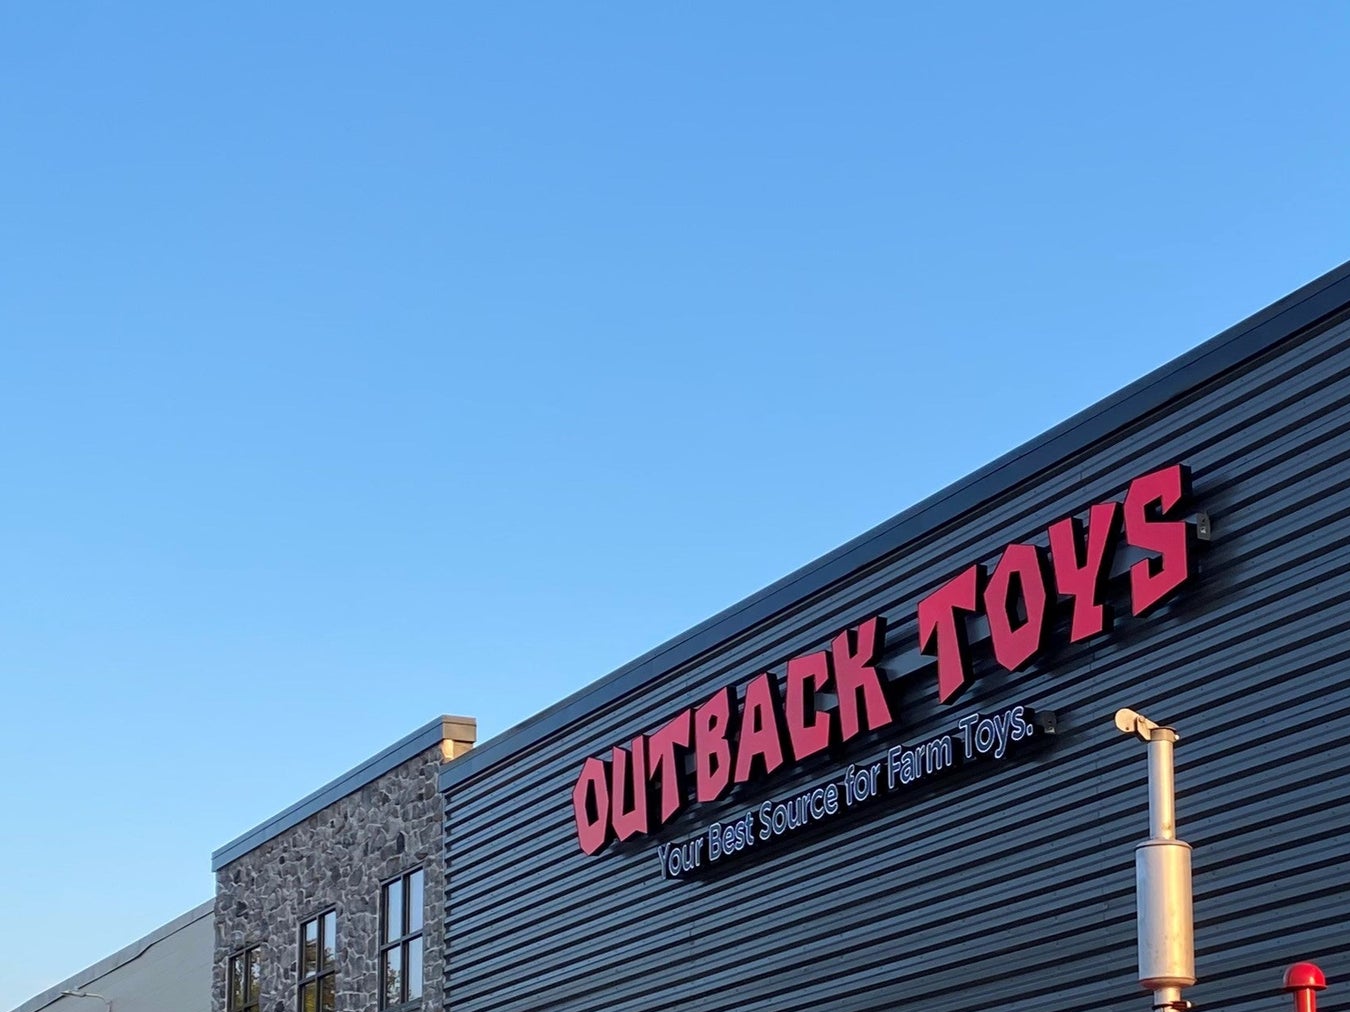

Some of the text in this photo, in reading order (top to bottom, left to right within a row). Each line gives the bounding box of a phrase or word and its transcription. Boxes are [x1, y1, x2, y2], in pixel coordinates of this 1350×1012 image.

[571, 463, 1191, 856] OUTBACK TOYS
[657, 706, 1033, 880] Your Best Source for Farm Toys.
